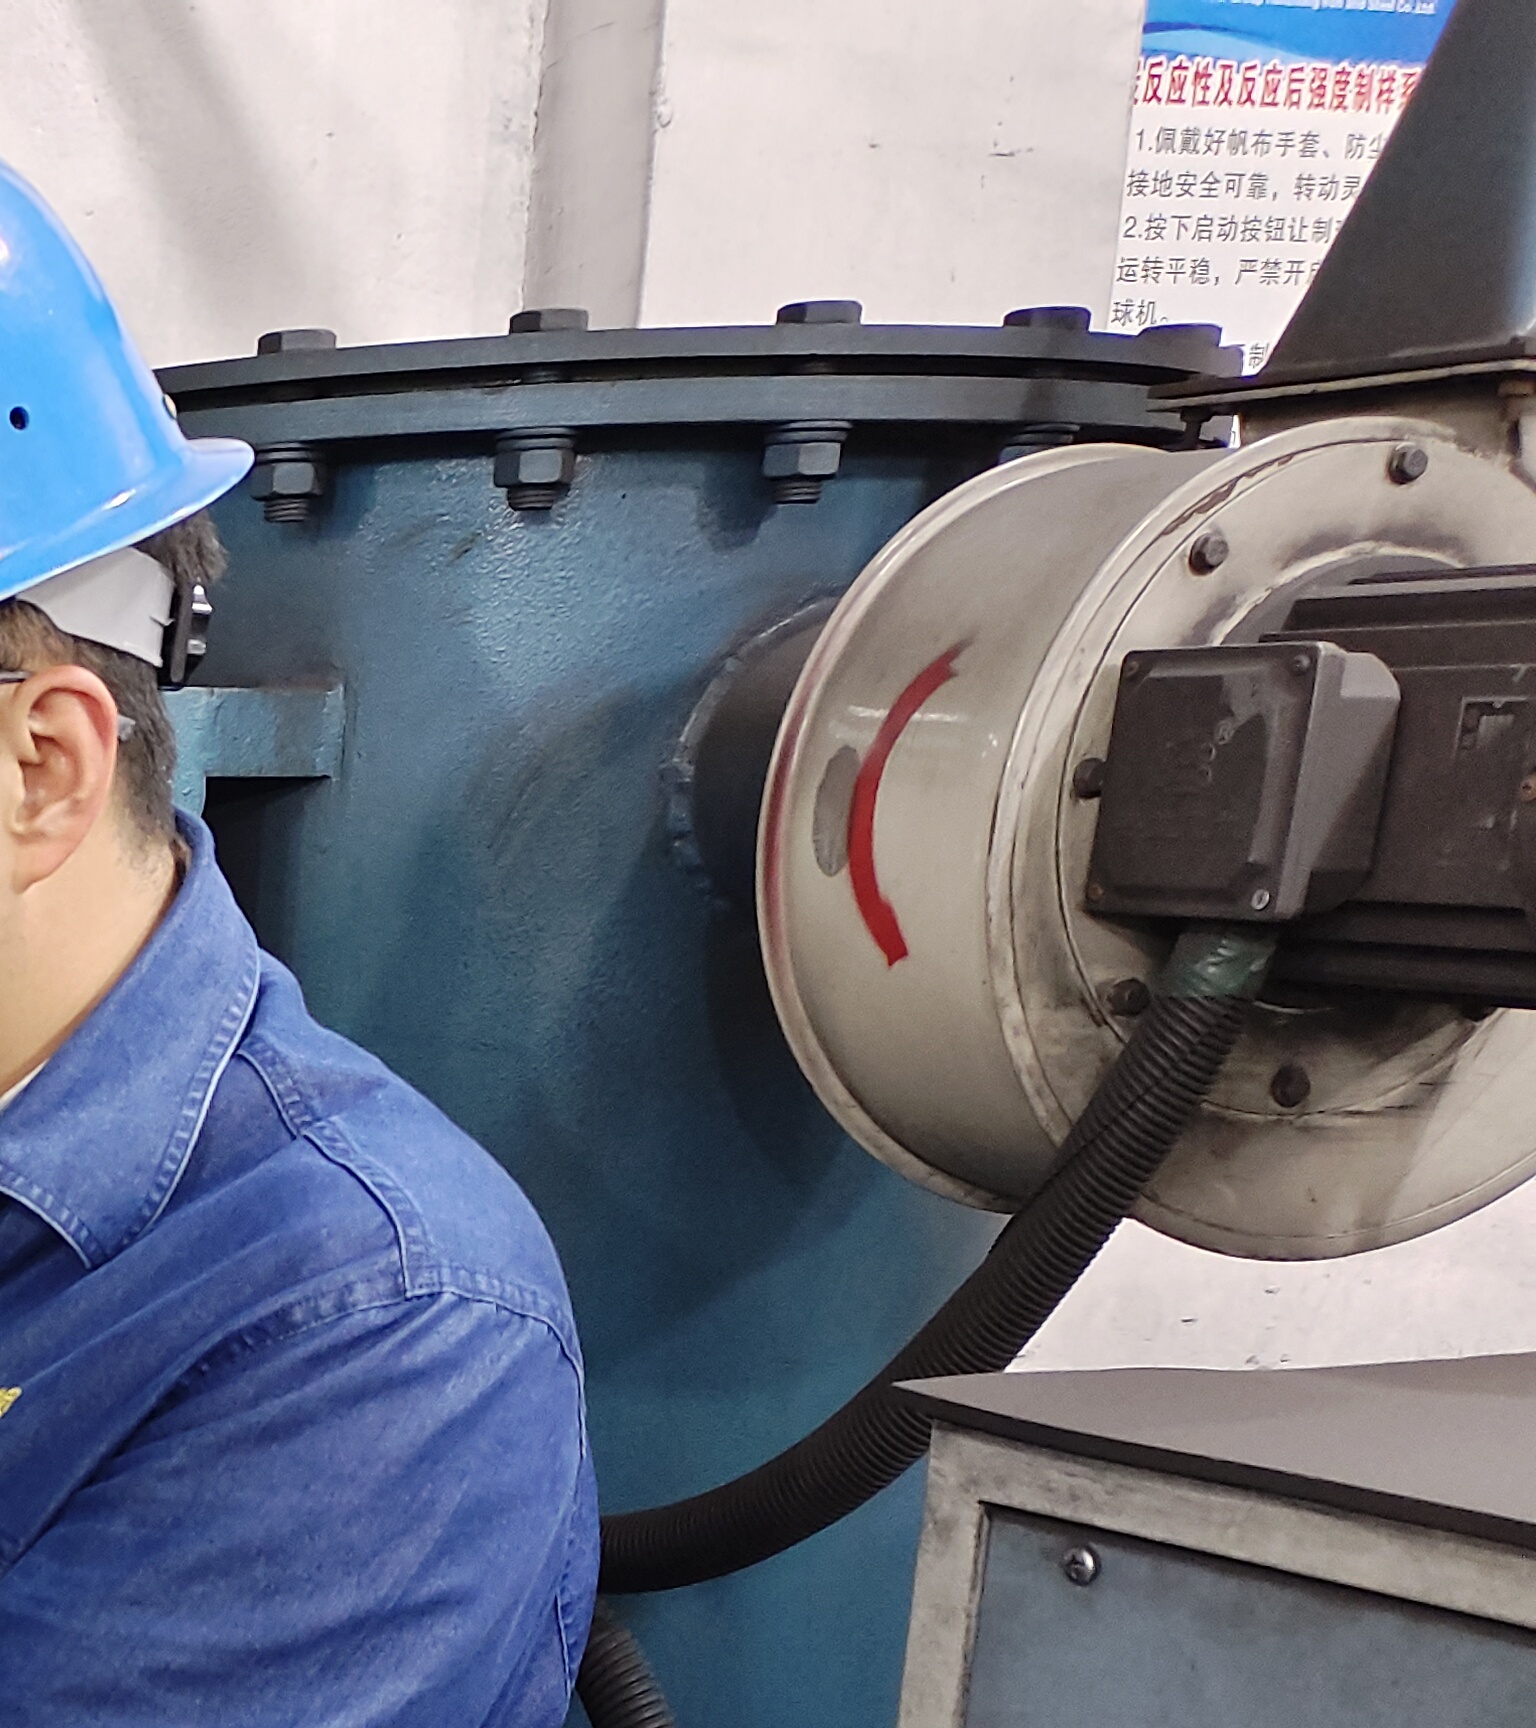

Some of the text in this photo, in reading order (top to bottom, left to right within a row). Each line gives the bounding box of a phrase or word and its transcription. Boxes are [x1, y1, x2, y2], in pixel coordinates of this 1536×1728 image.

[1133, 59, 1418, 114] 反应性及反应后强度制样系
[1123, 213, 1342, 244] 2.按下启动按钮让制
